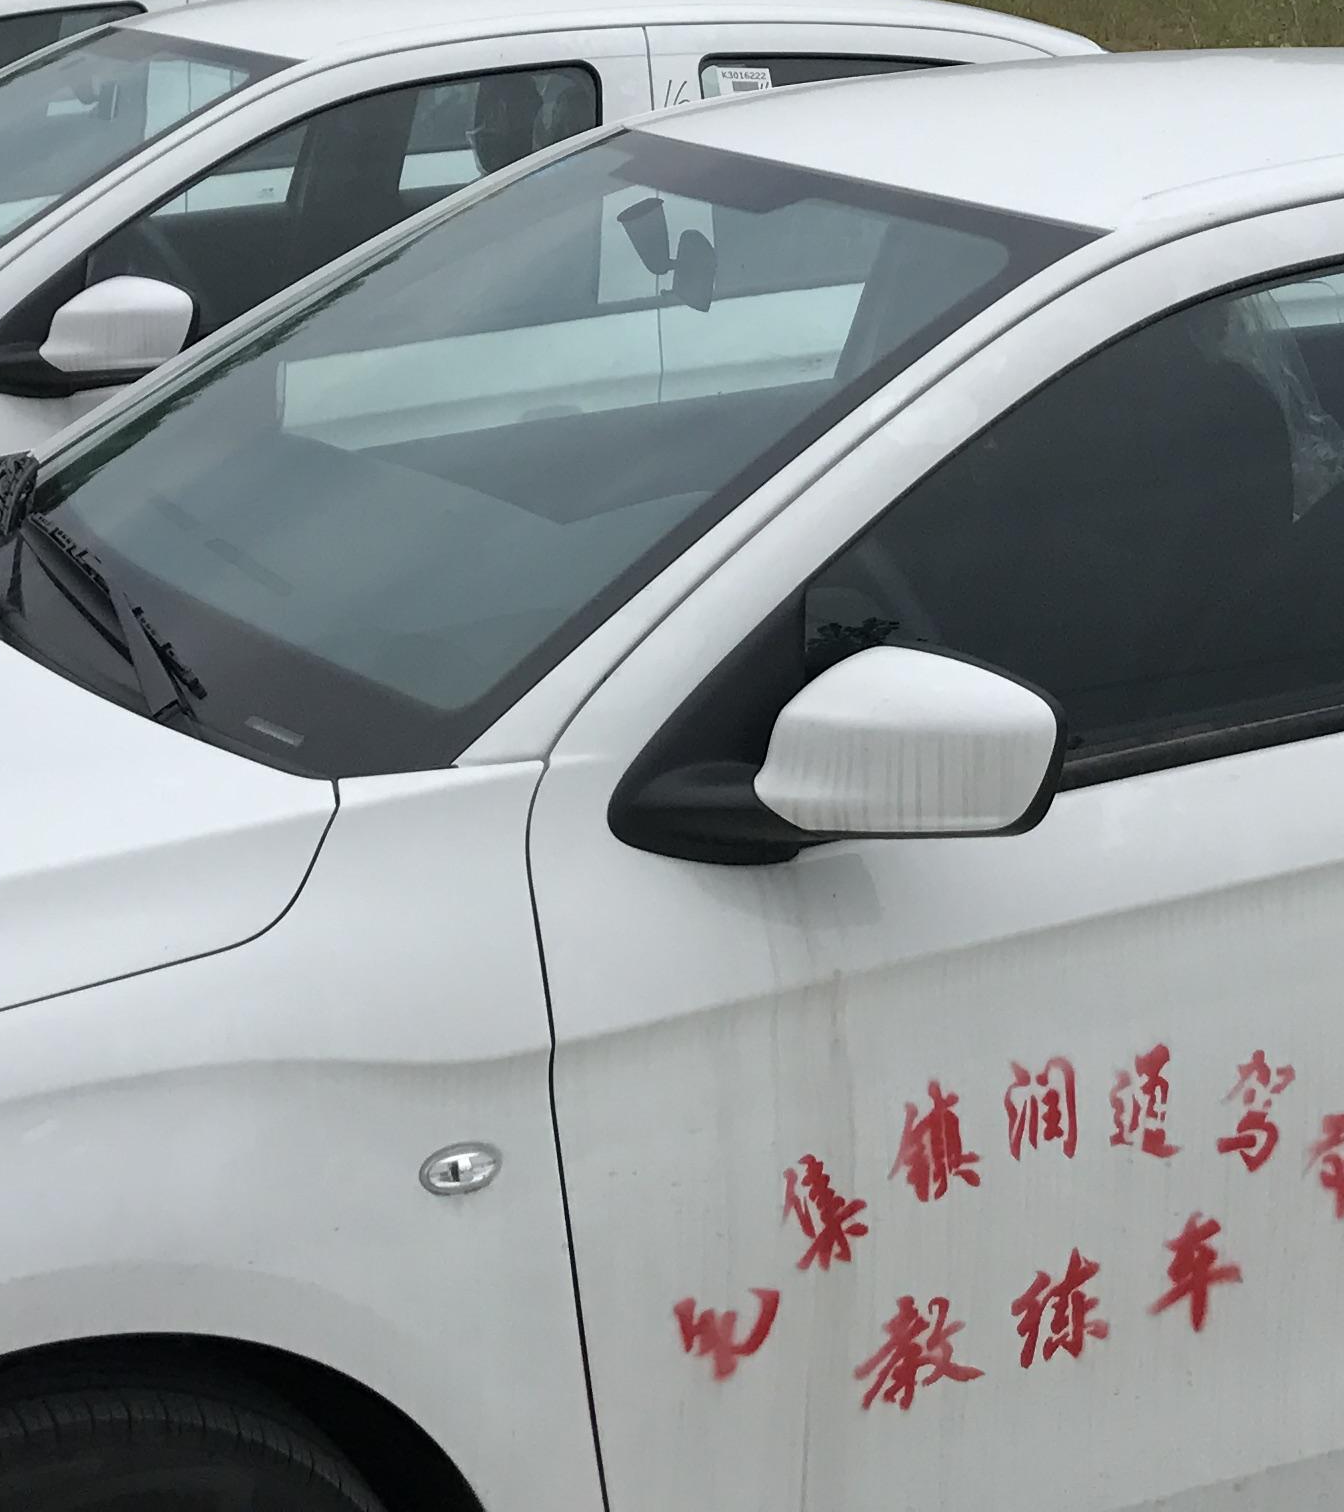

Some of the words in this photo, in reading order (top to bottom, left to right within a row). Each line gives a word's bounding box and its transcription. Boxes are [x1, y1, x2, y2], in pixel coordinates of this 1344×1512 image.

[721, 71, 767, 80] K3016222
[855, 1211, 1242, 1411] 教练车
